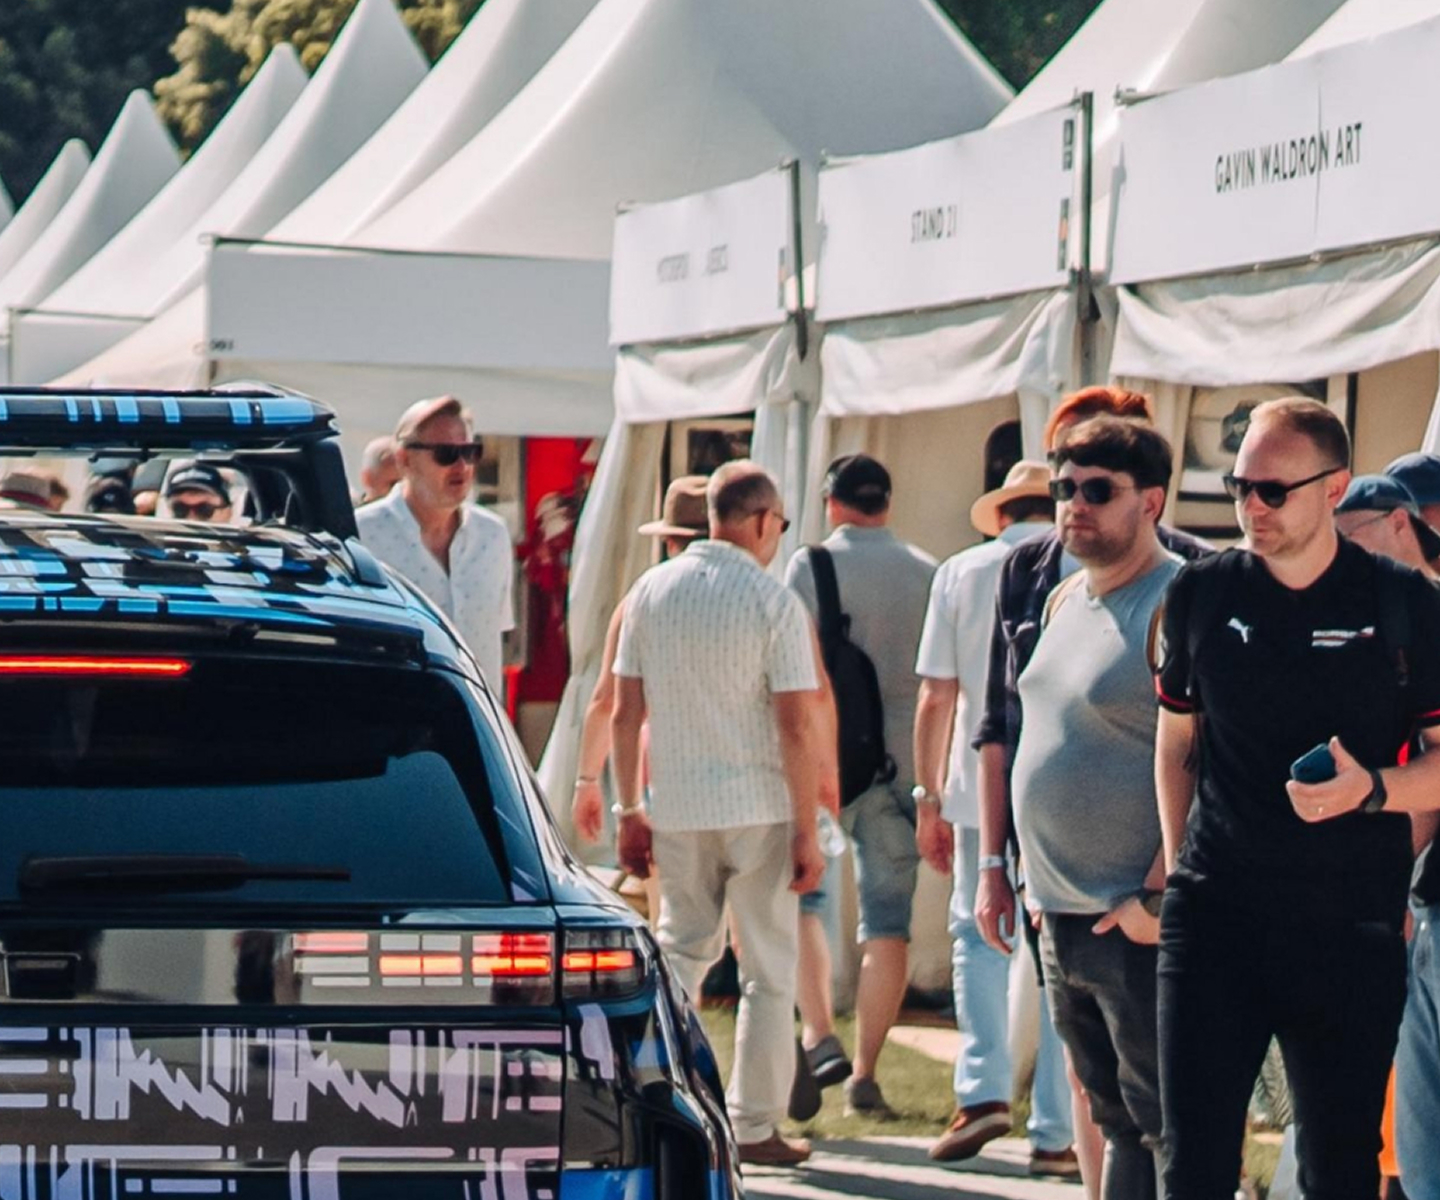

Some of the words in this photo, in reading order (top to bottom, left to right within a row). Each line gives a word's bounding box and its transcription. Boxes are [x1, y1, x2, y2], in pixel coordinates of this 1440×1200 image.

[1215, 150, 1255, 193] GAVIN
[1259, 130, 1330, 184] WALDRON
[1335, 123, 1362, 167] ART
[911, 206, 944, 243] STAND
